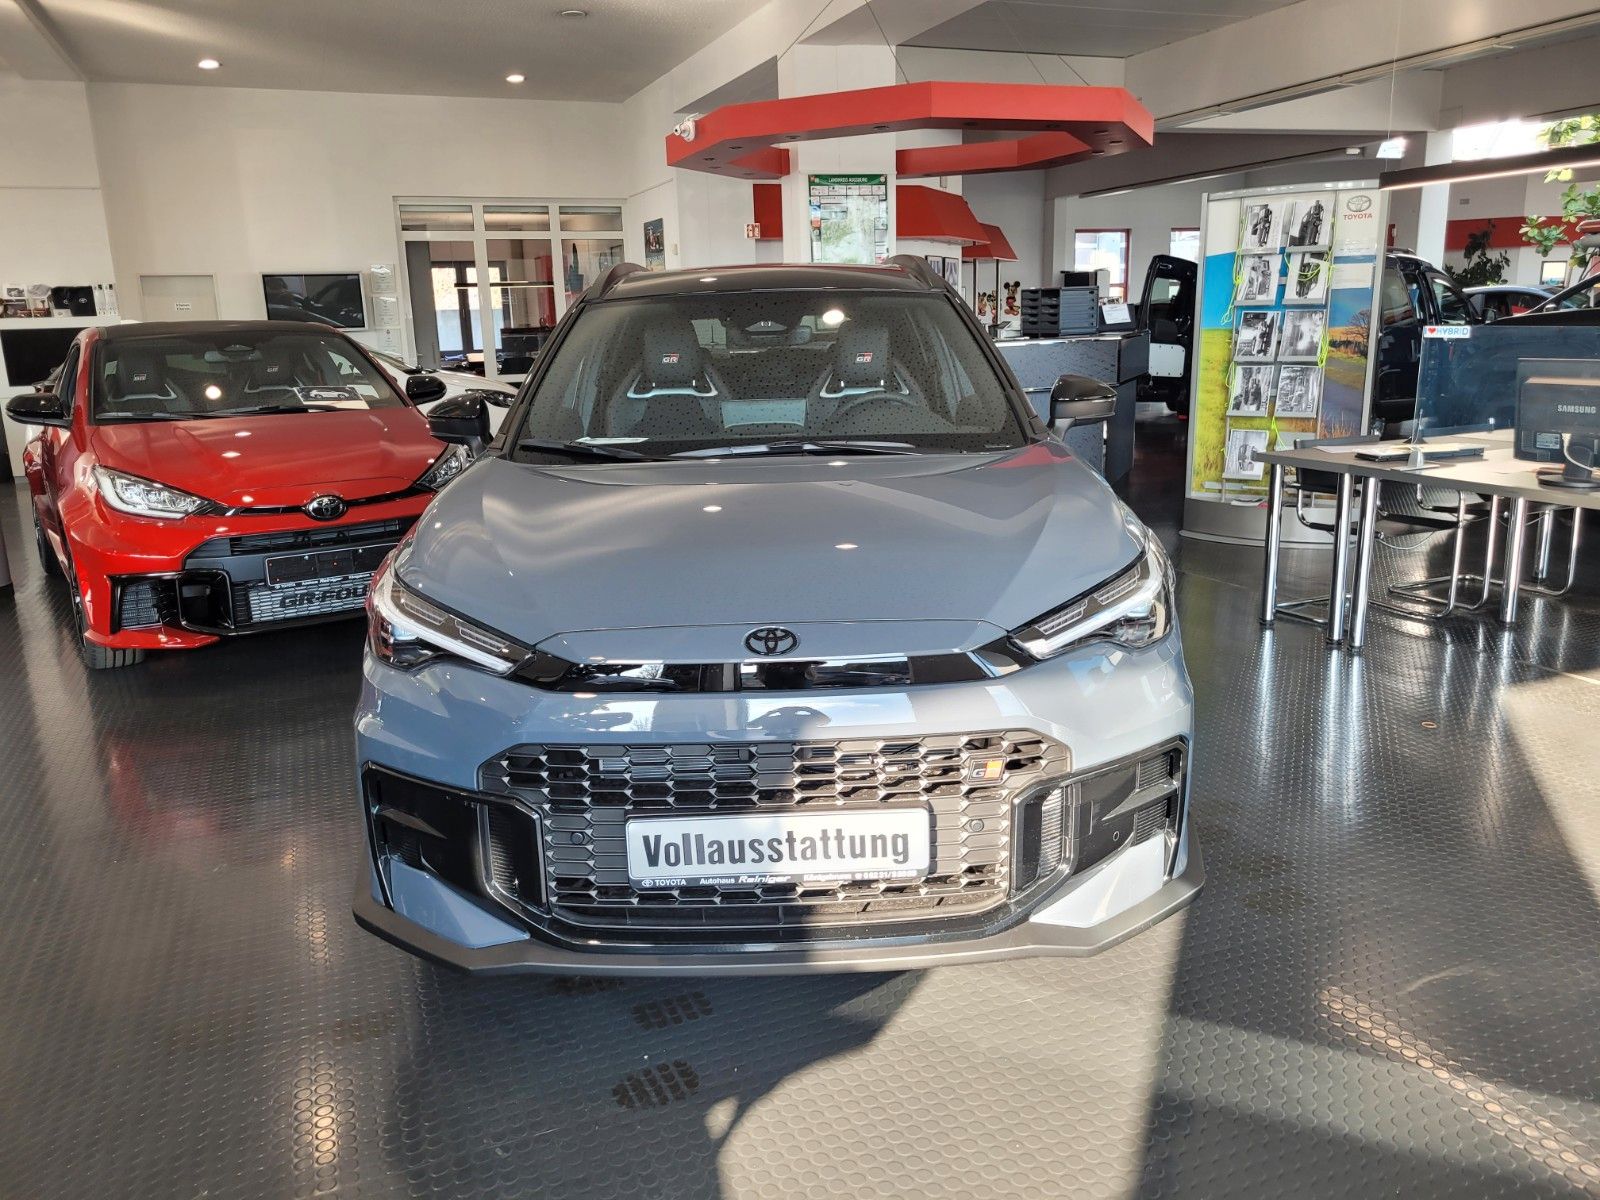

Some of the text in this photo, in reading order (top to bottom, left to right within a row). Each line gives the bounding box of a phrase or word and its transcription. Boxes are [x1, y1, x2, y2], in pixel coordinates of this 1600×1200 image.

[1437, 327, 1469, 336] HYBRID
[662, 355, 679, 363] GR
[856, 354, 873, 362] GR
[1557, 404, 1597, 414] SAMSUNG
[642, 828, 910, 868] Vollausstattung
[654, 878, 687, 886] TOYOTA
[700, 877, 736, 885] Autohaus
